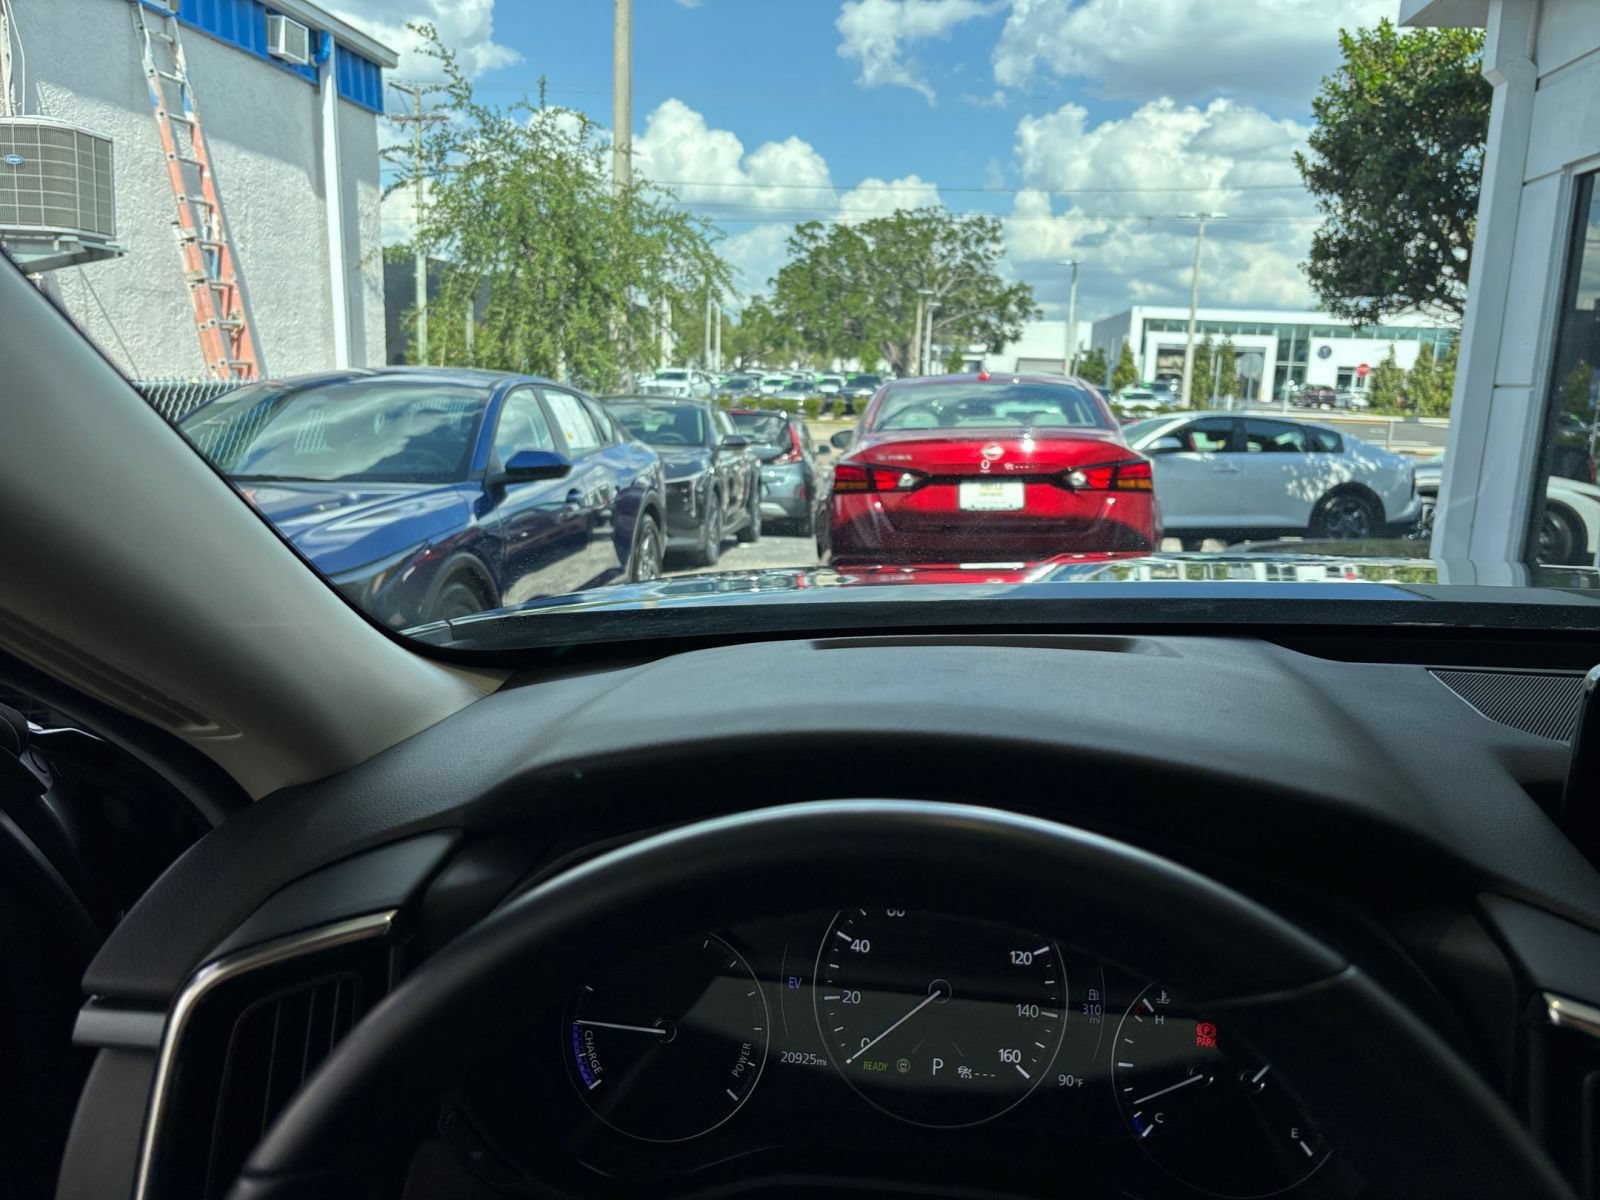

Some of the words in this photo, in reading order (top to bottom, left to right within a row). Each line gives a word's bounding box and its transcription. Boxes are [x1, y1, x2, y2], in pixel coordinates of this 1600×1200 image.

[851, 939, 871, 953] 40
[1009, 950, 1033, 965] 120
[788, 977, 802, 989] EV
[842, 990, 861, 1004] 20
[1016, 1004, 1039, 1018] 140
[1082, 1003, 1101, 1016] 310
[1154, 1015, 1165, 1025] H
[1196, 1036, 1218, 1049] PARK
[584, 1029, 604, 1075] CHARGE
[998, 1048, 1022, 1064] 160
[731, 1042, 752, 1078] POWER
[863, 1060, 889, 1072] READY
[932, 1058, 944, 1076] P
[1154, 1112, 1164, 1124] C
[1291, 1128, 1299, 1139] E
